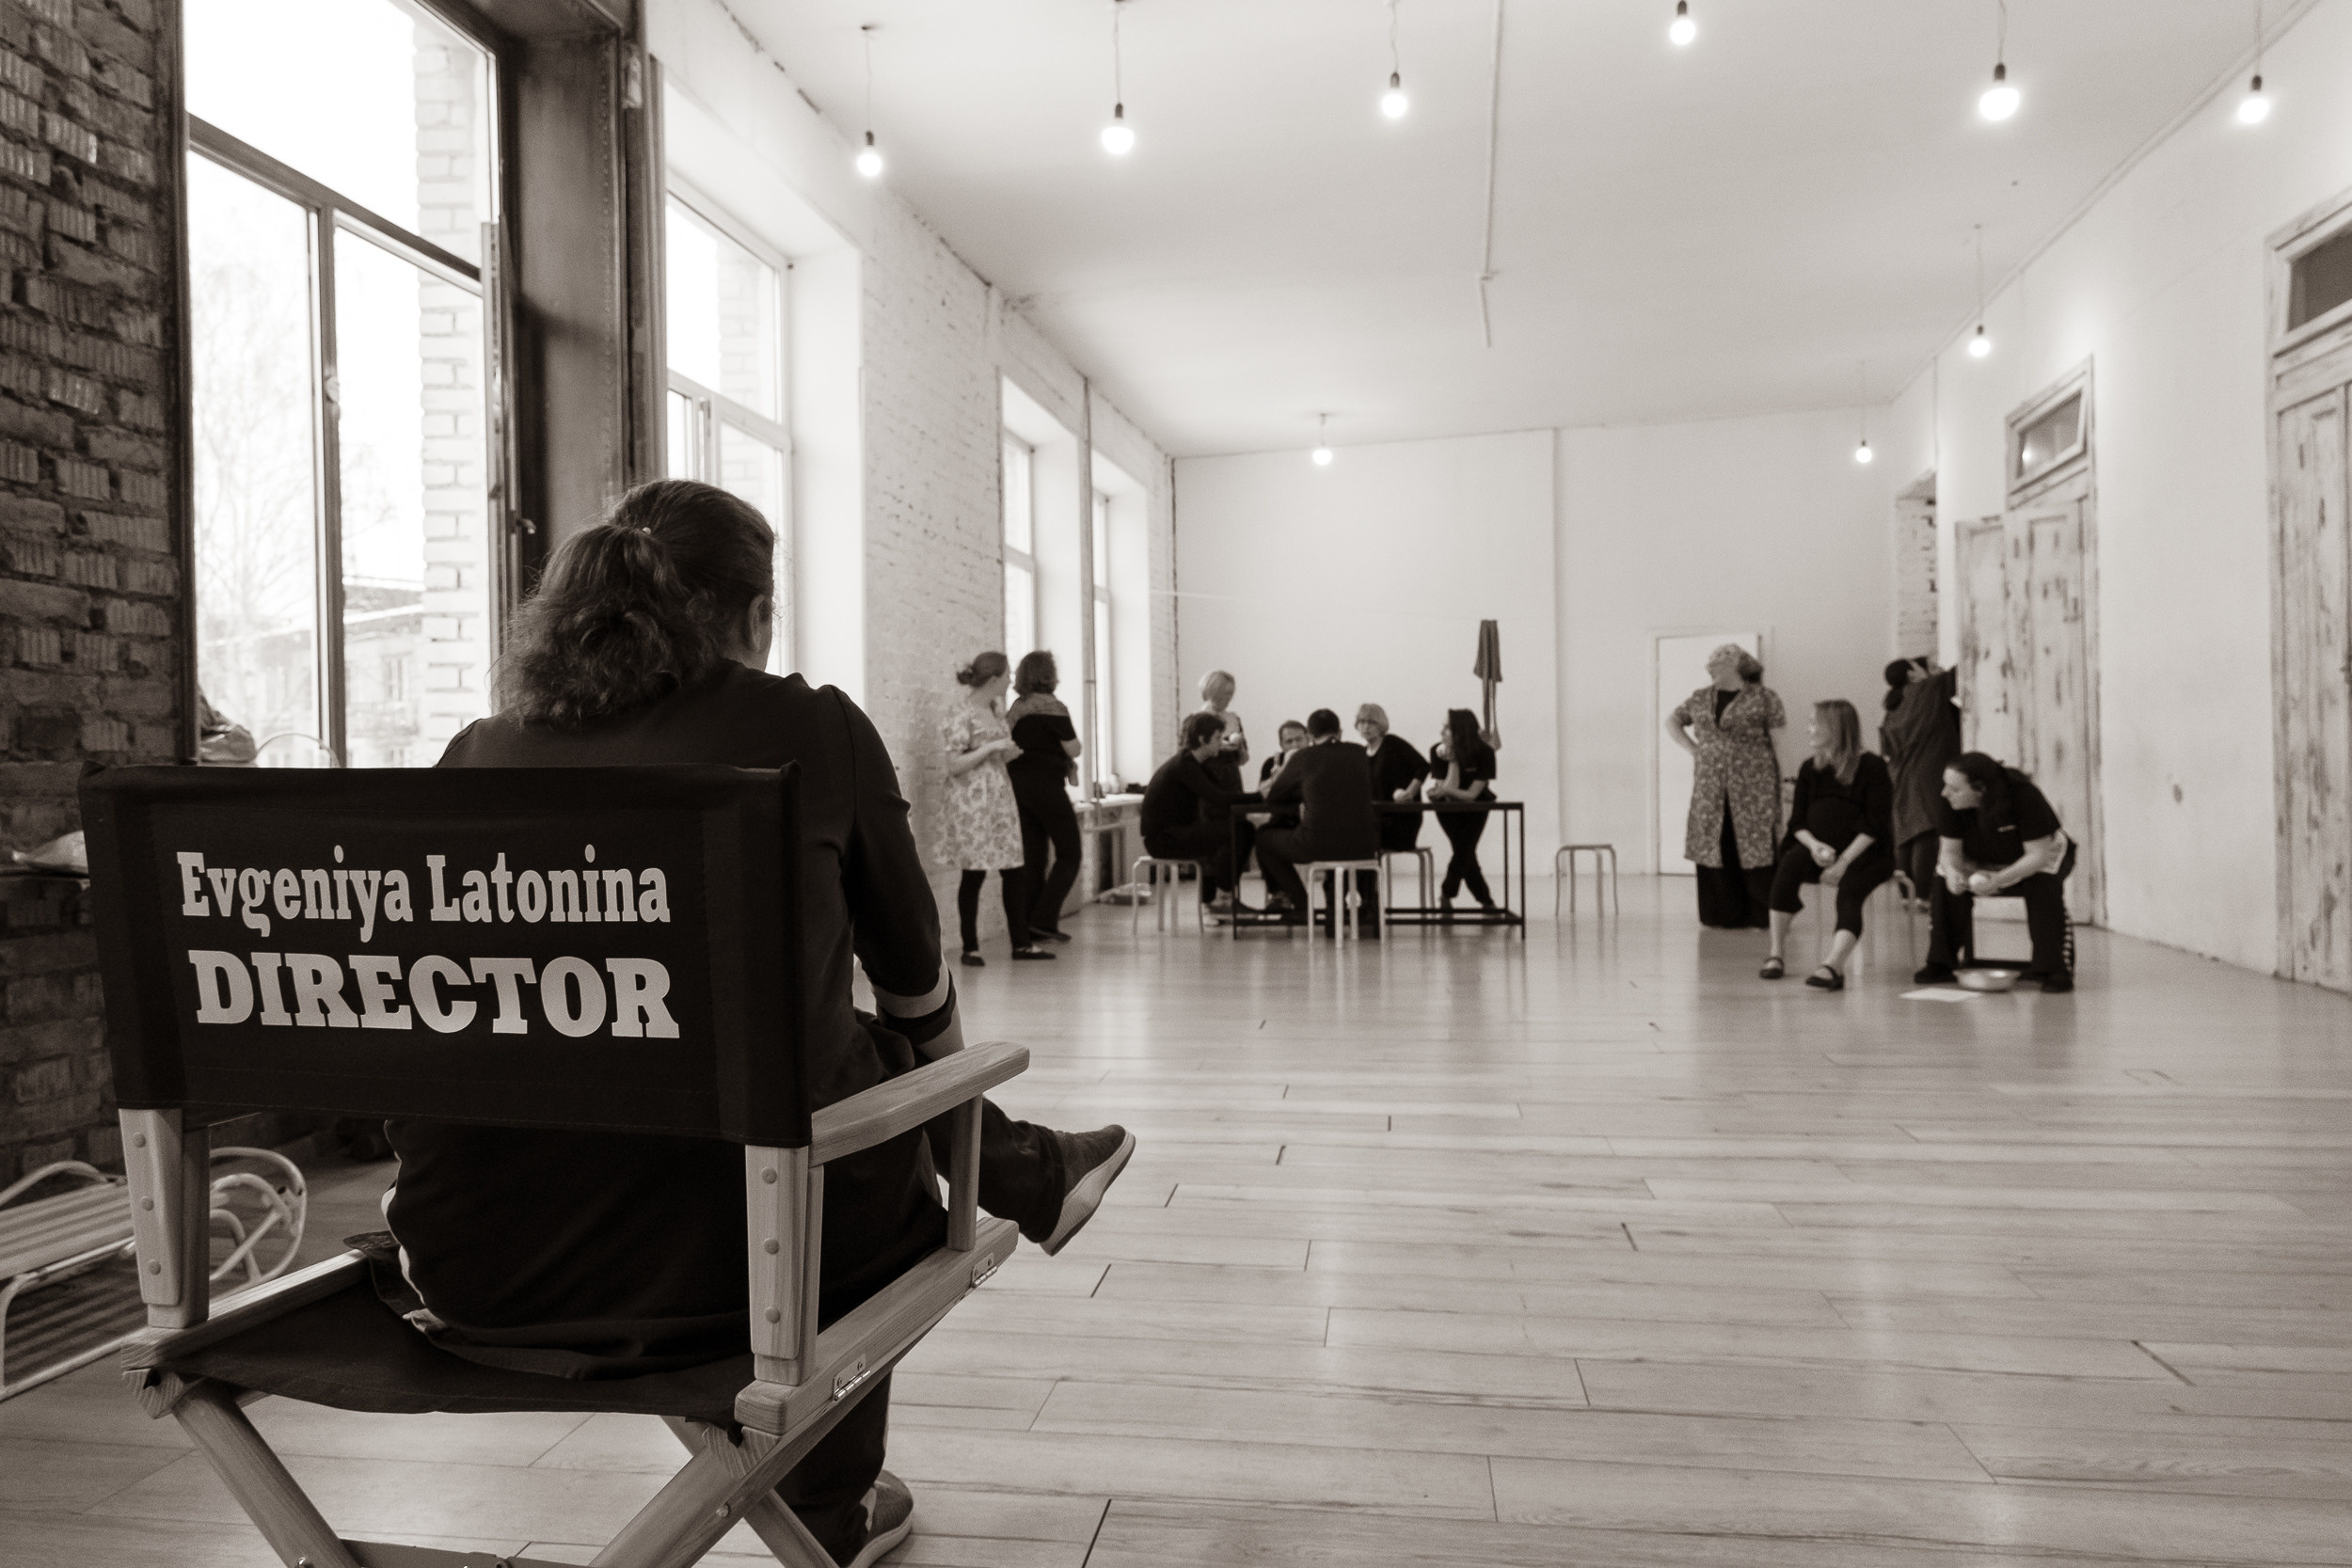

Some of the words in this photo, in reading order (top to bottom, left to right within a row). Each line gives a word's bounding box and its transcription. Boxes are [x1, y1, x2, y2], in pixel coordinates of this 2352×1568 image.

[177, 845, 414, 943] Evgeniya
[426, 844, 671, 924] Latonina
[188, 949, 680, 1038] DIRECTOR
